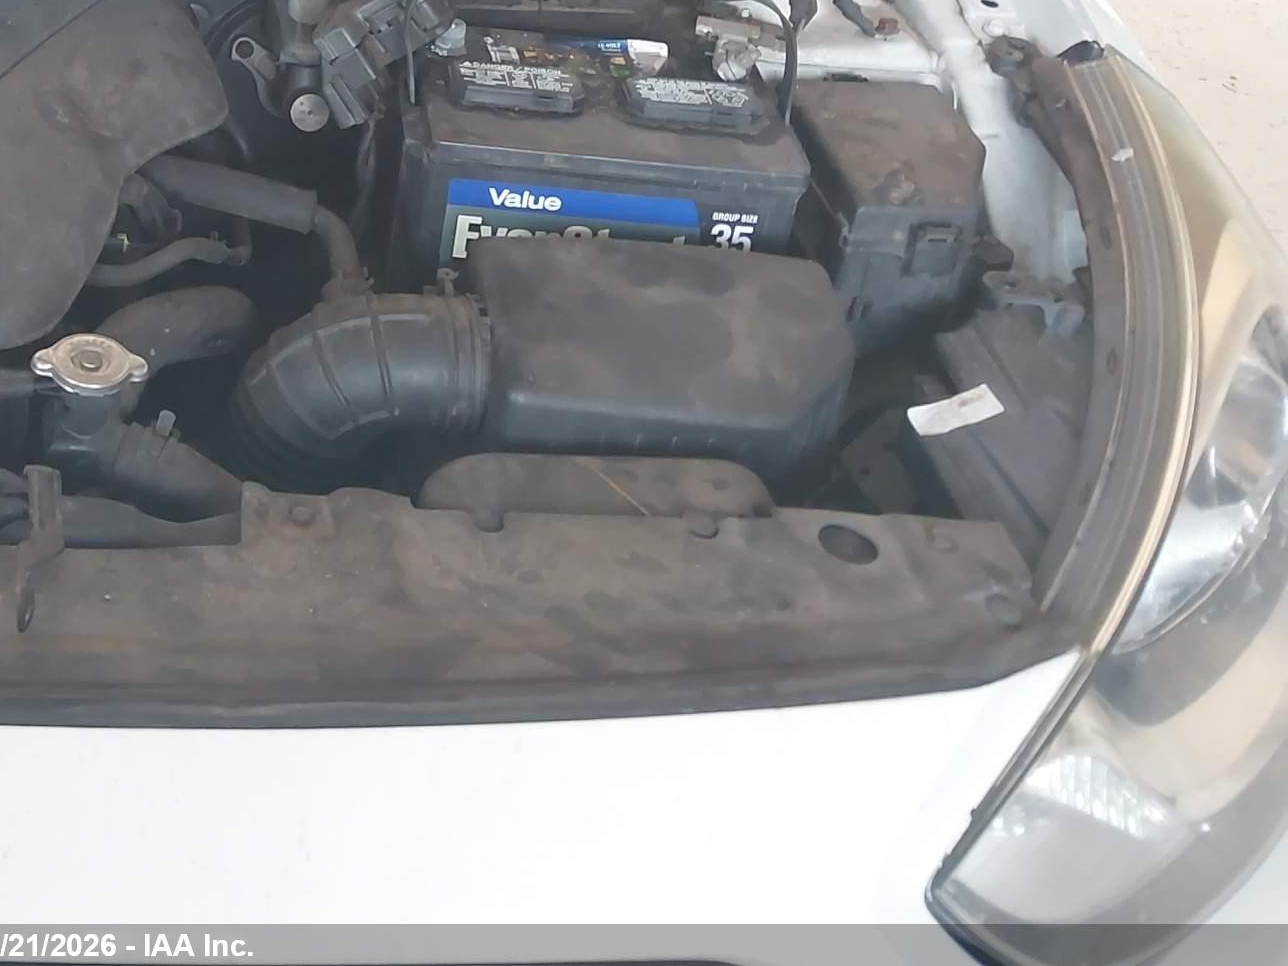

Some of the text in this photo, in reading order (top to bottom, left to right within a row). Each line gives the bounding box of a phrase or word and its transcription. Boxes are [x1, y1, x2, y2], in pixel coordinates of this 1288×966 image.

[488, 187, 562, 212] Value
[712, 211, 759, 224] GROUP SIZE
[710, 223, 754, 253] 35
